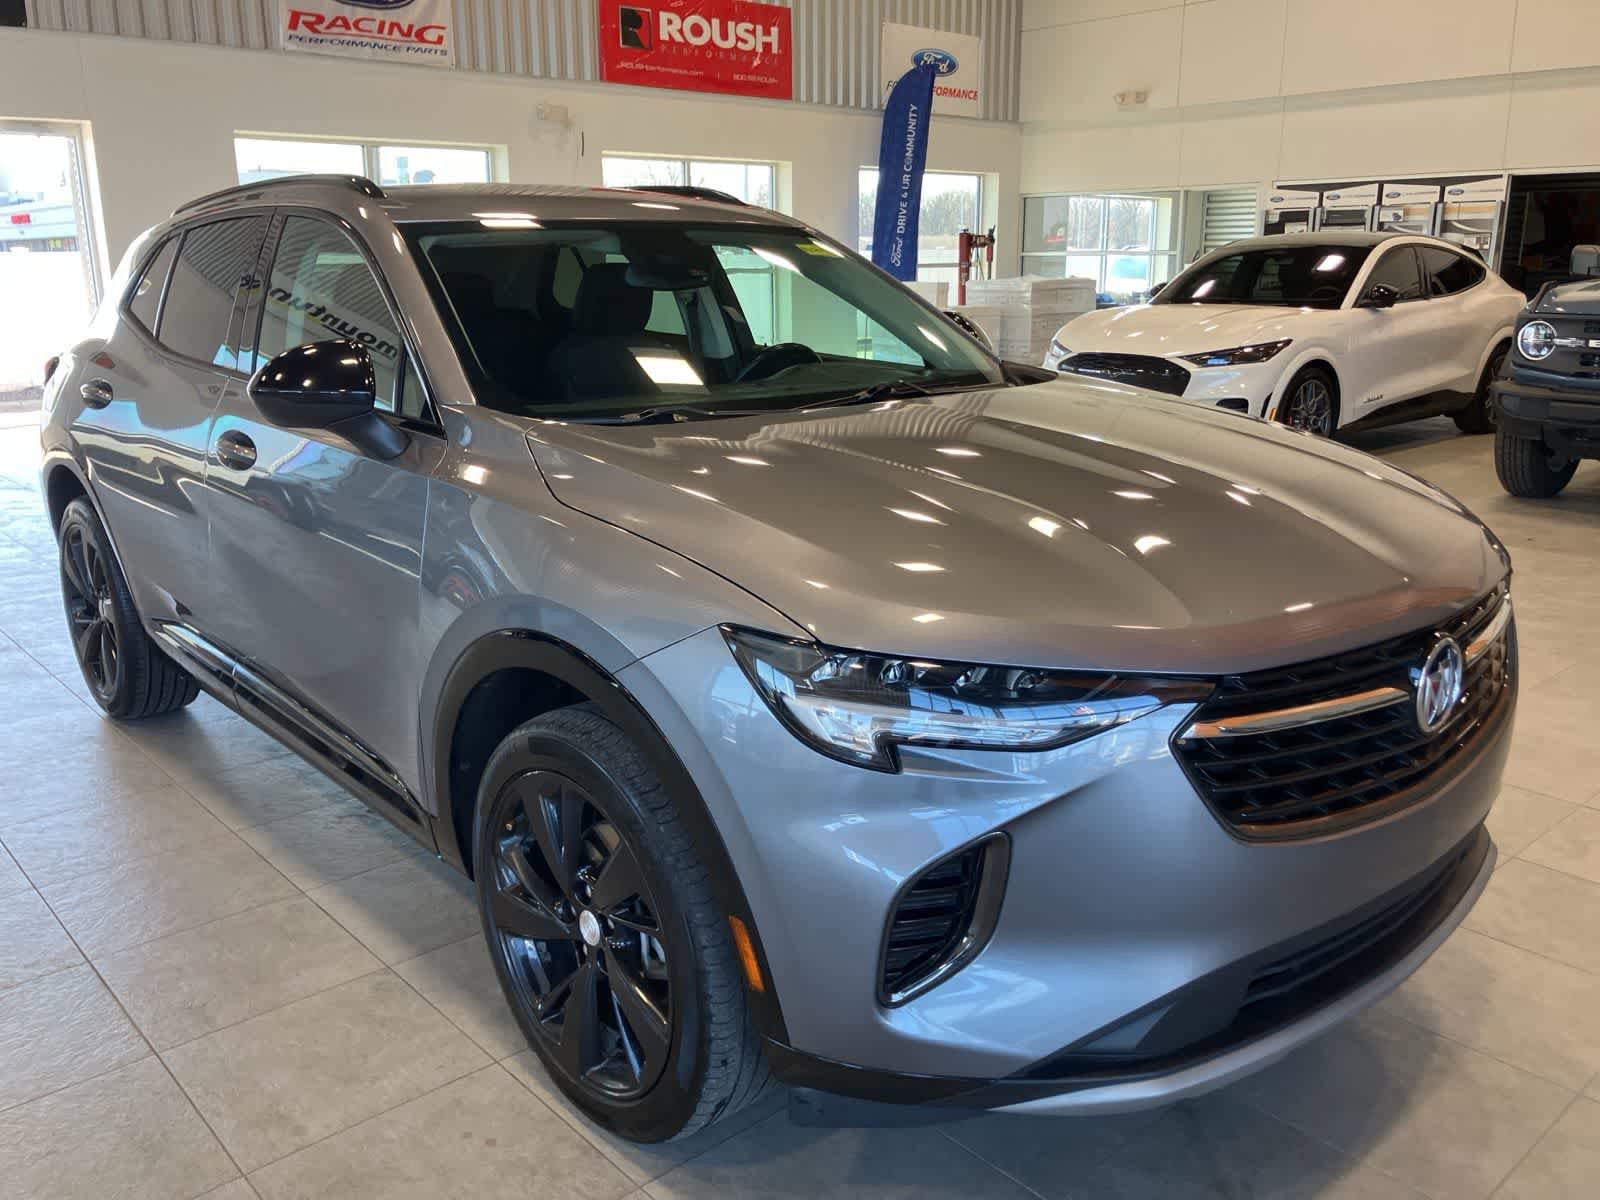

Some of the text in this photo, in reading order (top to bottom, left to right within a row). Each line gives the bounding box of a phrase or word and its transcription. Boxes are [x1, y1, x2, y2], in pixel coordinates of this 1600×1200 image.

[288, 9, 447, 45] RACING
[659, 10, 778, 54] ROUSH
[288, 34, 448, 56] PERFORMANCE PARTS
[903, 103, 918, 172] COMMUNITY
[902, 174, 911, 190] UR
[897, 200, 908, 234] DRIVE
[890, 237, 903, 267] Ford
